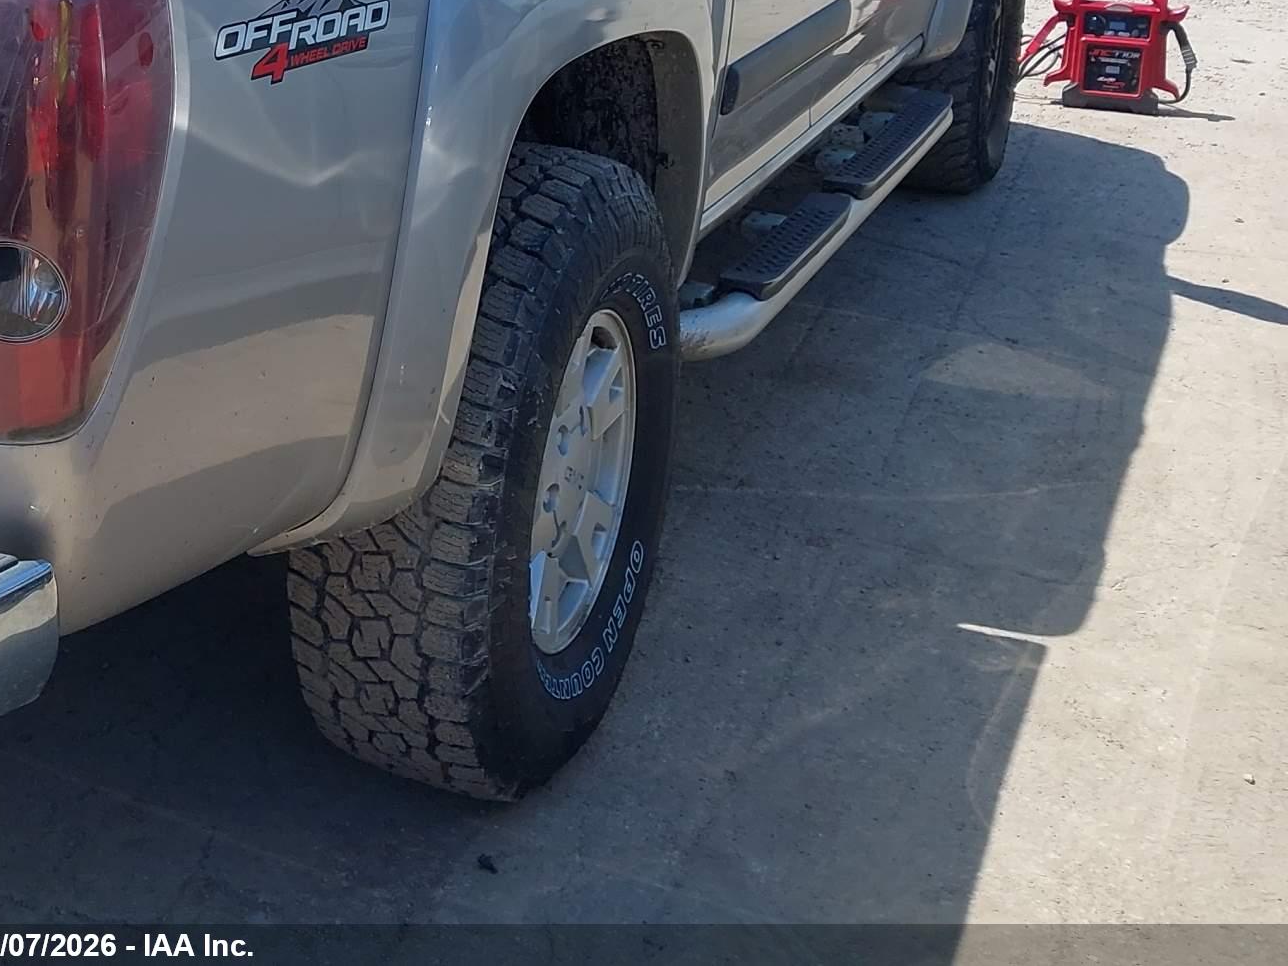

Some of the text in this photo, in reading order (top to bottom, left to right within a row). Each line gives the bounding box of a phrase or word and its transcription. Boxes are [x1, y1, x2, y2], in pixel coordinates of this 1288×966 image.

[252, 36, 367, 83] 4 WHEEL DRIVE
[602, 539, 644, 653] OPEN
